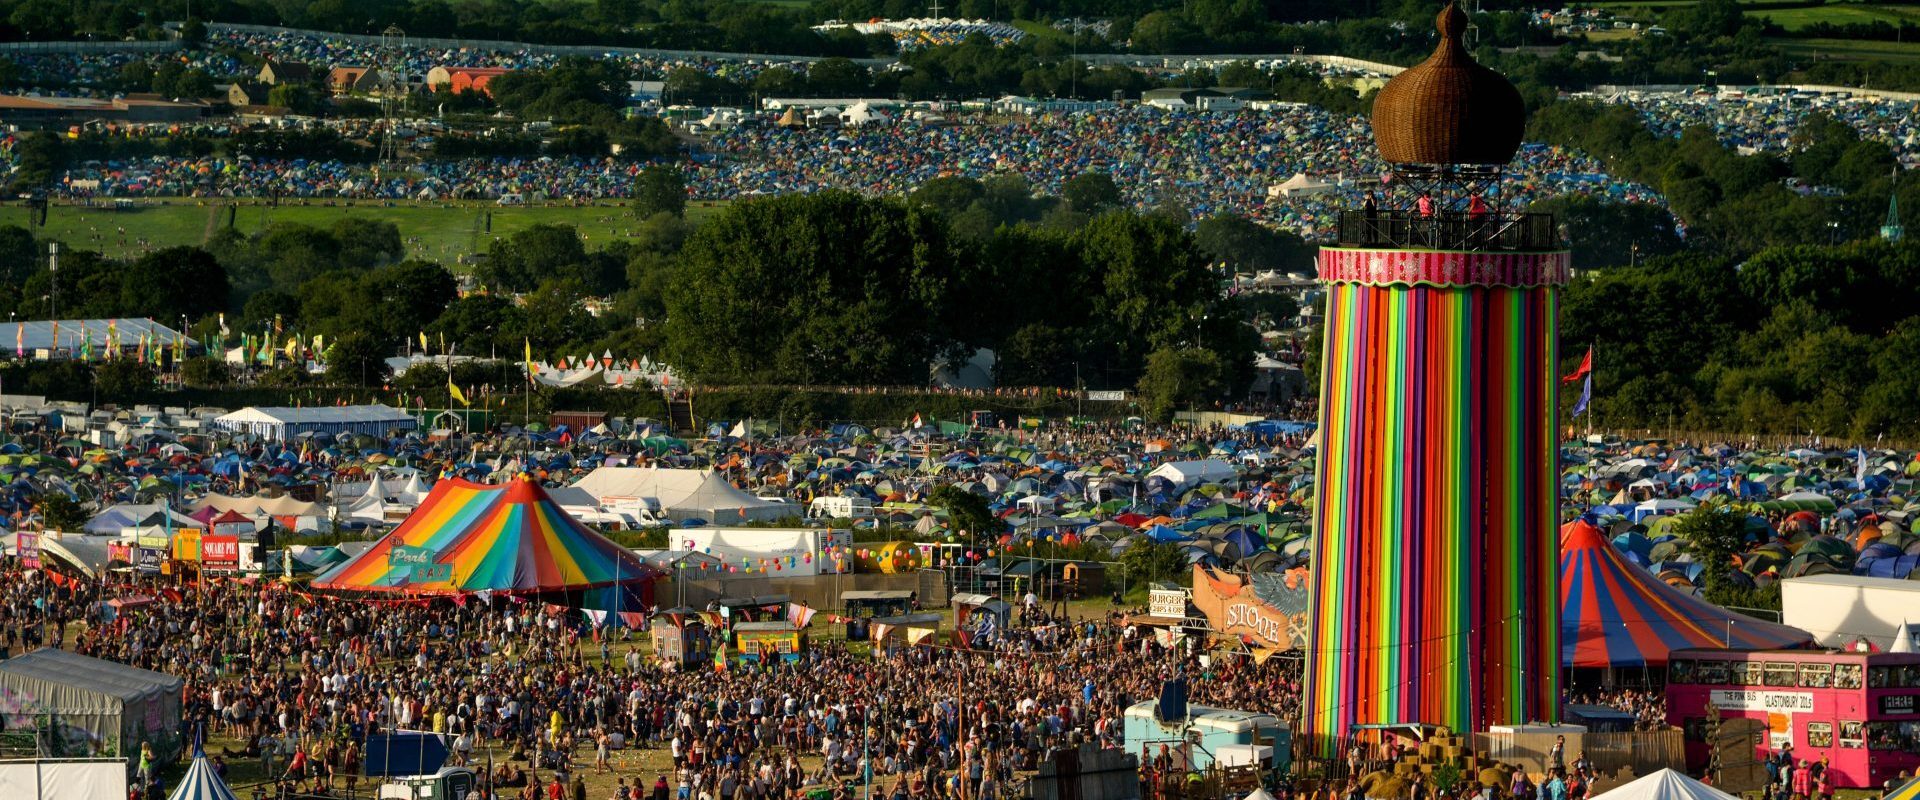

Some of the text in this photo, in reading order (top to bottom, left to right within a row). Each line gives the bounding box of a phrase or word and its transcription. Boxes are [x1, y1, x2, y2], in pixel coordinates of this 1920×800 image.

[204, 542, 236, 557] SQUARE PIE
[393, 548, 428, 563] Park
[418, 567, 445, 579] BAR
[1149, 592, 1186, 605] BURGERS
[1724, 692, 1757, 701] THE PINK BUS
[1765, 694, 1812, 708] GLASTONBURY 2015
